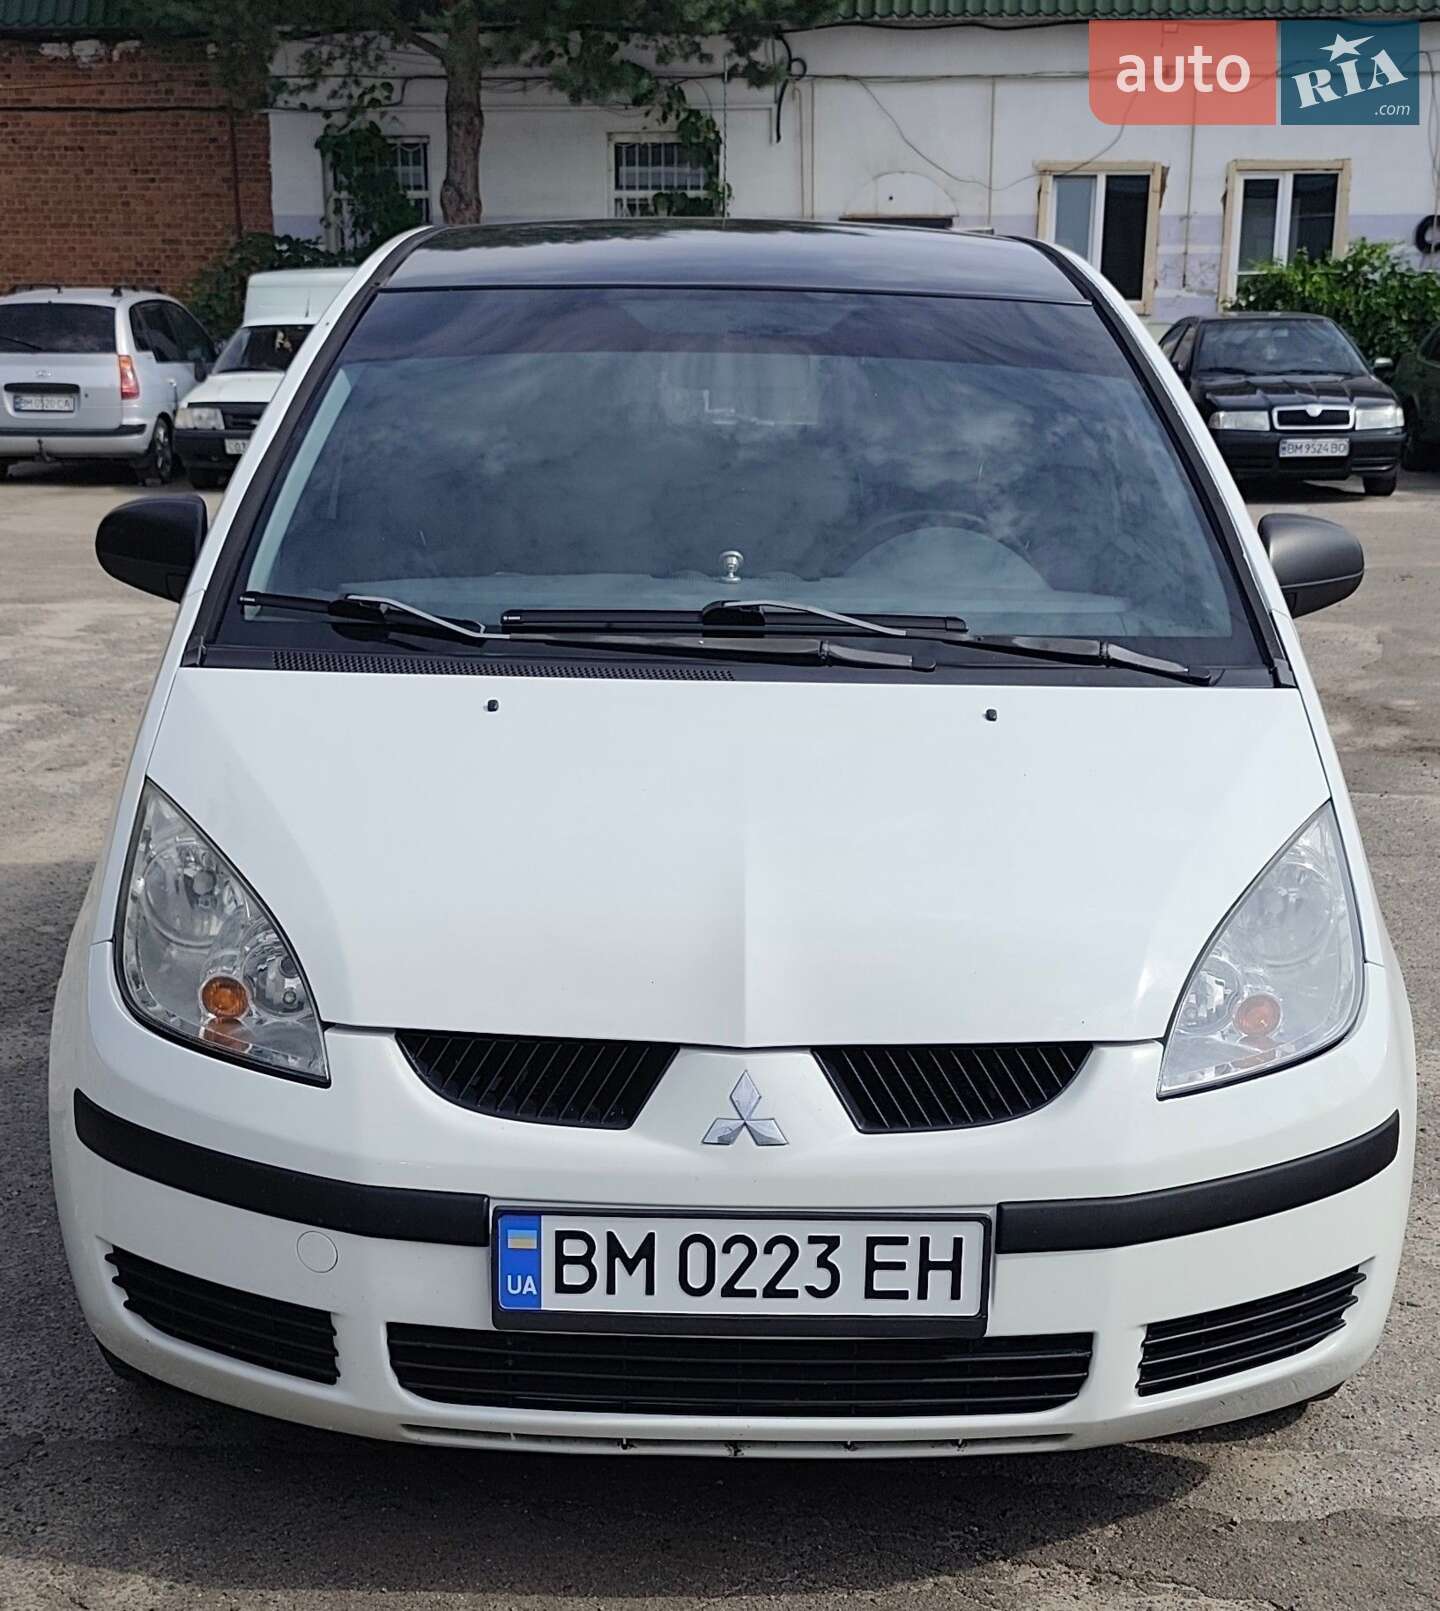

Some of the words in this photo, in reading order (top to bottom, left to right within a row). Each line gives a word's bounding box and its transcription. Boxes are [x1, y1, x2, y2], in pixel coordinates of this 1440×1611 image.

[1304, 443, 1329, 454] 9524
[554, 1229, 656, 1295] BM
[678, 1233, 841, 1298] 0223
[864, 1236, 964, 1300] EH
[507, 1275, 538, 1295] UA
